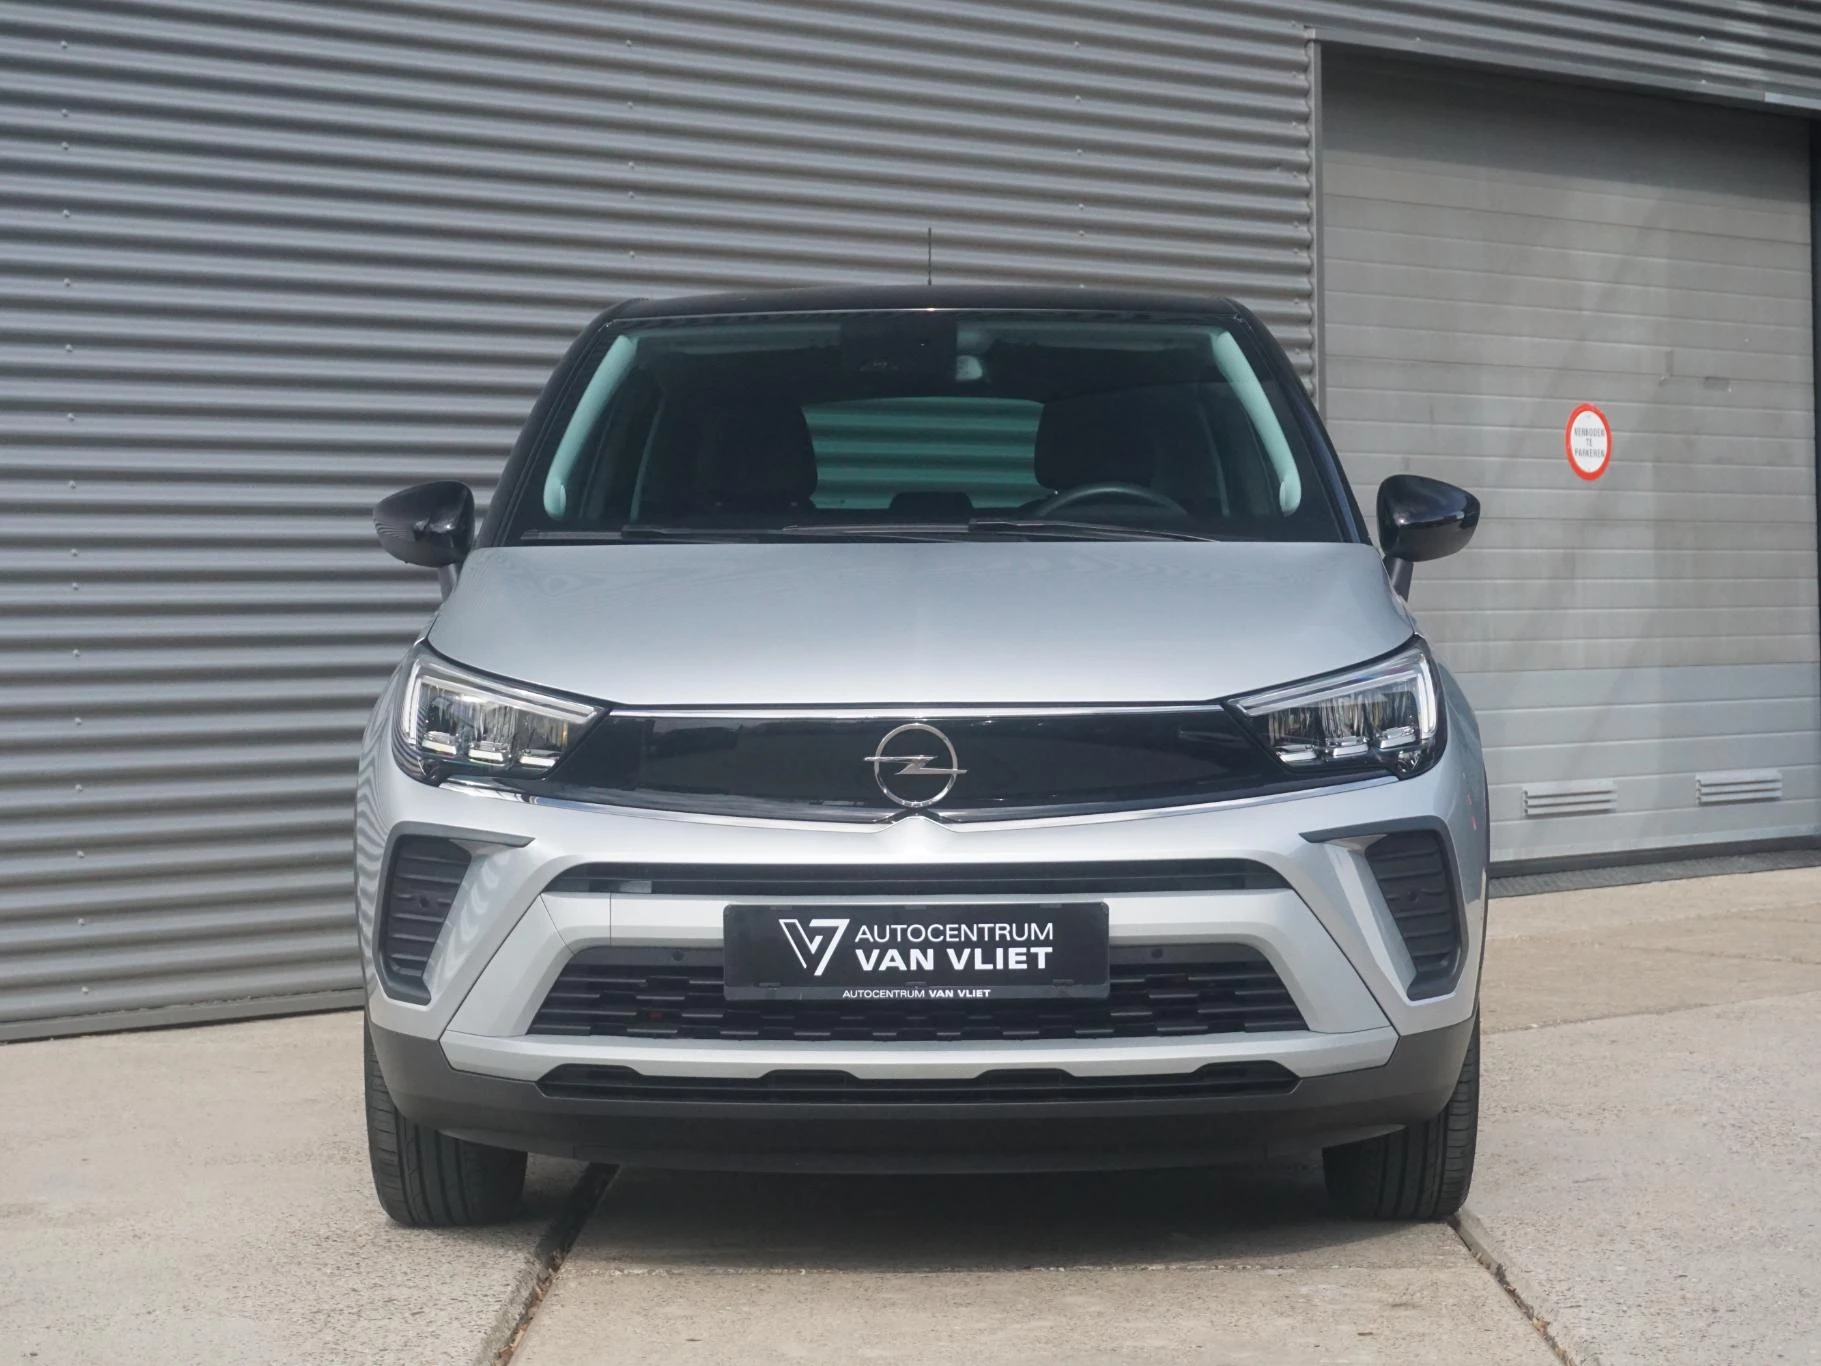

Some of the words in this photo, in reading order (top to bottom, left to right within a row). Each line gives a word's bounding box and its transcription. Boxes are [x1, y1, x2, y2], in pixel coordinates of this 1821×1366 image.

[854, 922, 1054, 943] AUTOCENTRUM
[855, 948, 934, 971] VAN
[946, 946, 1054, 970] VLIET
[842, 990, 925, 999] AUTOCENTRUM
[928, 989, 954, 998] VAN
[957, 989, 991, 998] VLIET
